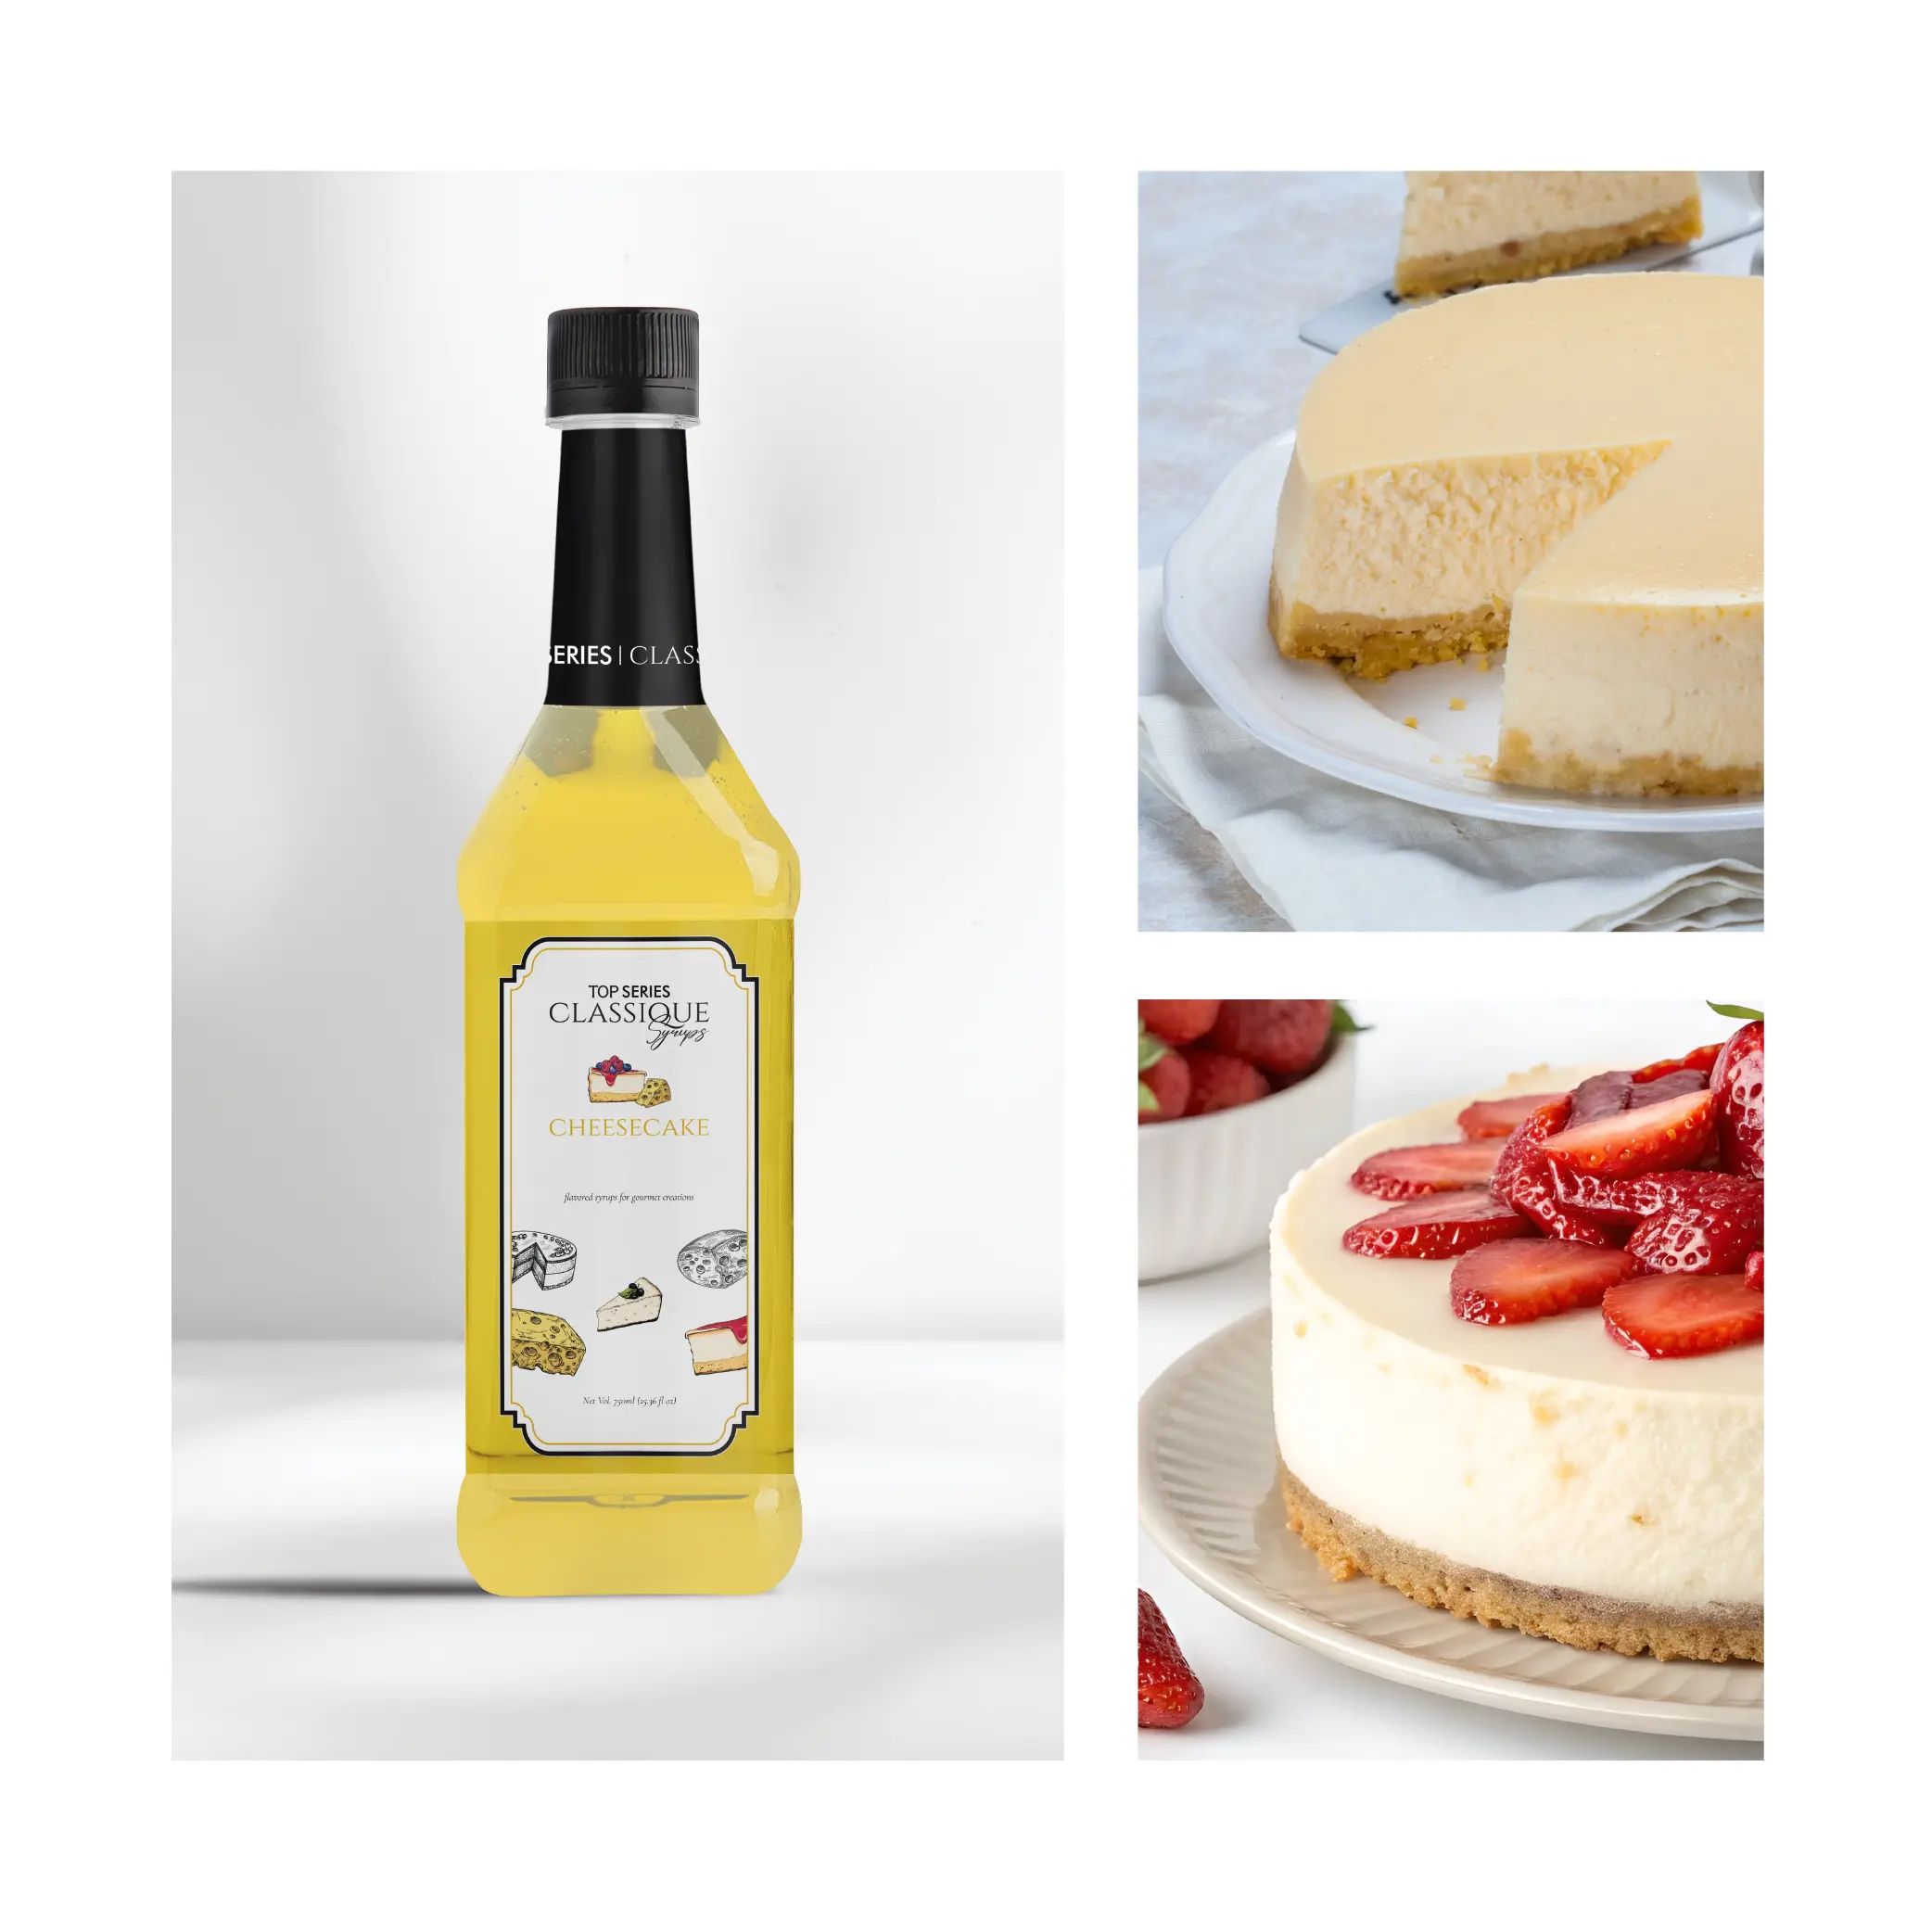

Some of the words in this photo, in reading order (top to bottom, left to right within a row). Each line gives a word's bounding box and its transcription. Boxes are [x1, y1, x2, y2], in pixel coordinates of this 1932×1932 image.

[588, 985, 619, 998] TOP
[621, 985, 671, 998] SERIES
[549, 1001, 710, 1029] CLASSIQUE
[645, 1013, 710, 1051] Syrups
[549, 1118, 710, 1137] CHEESECAKE
[564, 1191, 593, 1204] flavored
[594, 1193, 617, 1204] syrups
[618, 1191, 629, 1204] for
[630, 1195, 661, 1204] gourmet
[662, 1193, 694, 1202] creations
[582, 1395, 596, 1405] Net
[598, 1395, 611, 1405] Vol.
[613, 1395, 636, 1407] 750ml
[637, 1395, 656, 1408] (25.36
[657, 1395, 665, 1407] fl
[666, 1396, 677, 1405] oz)
